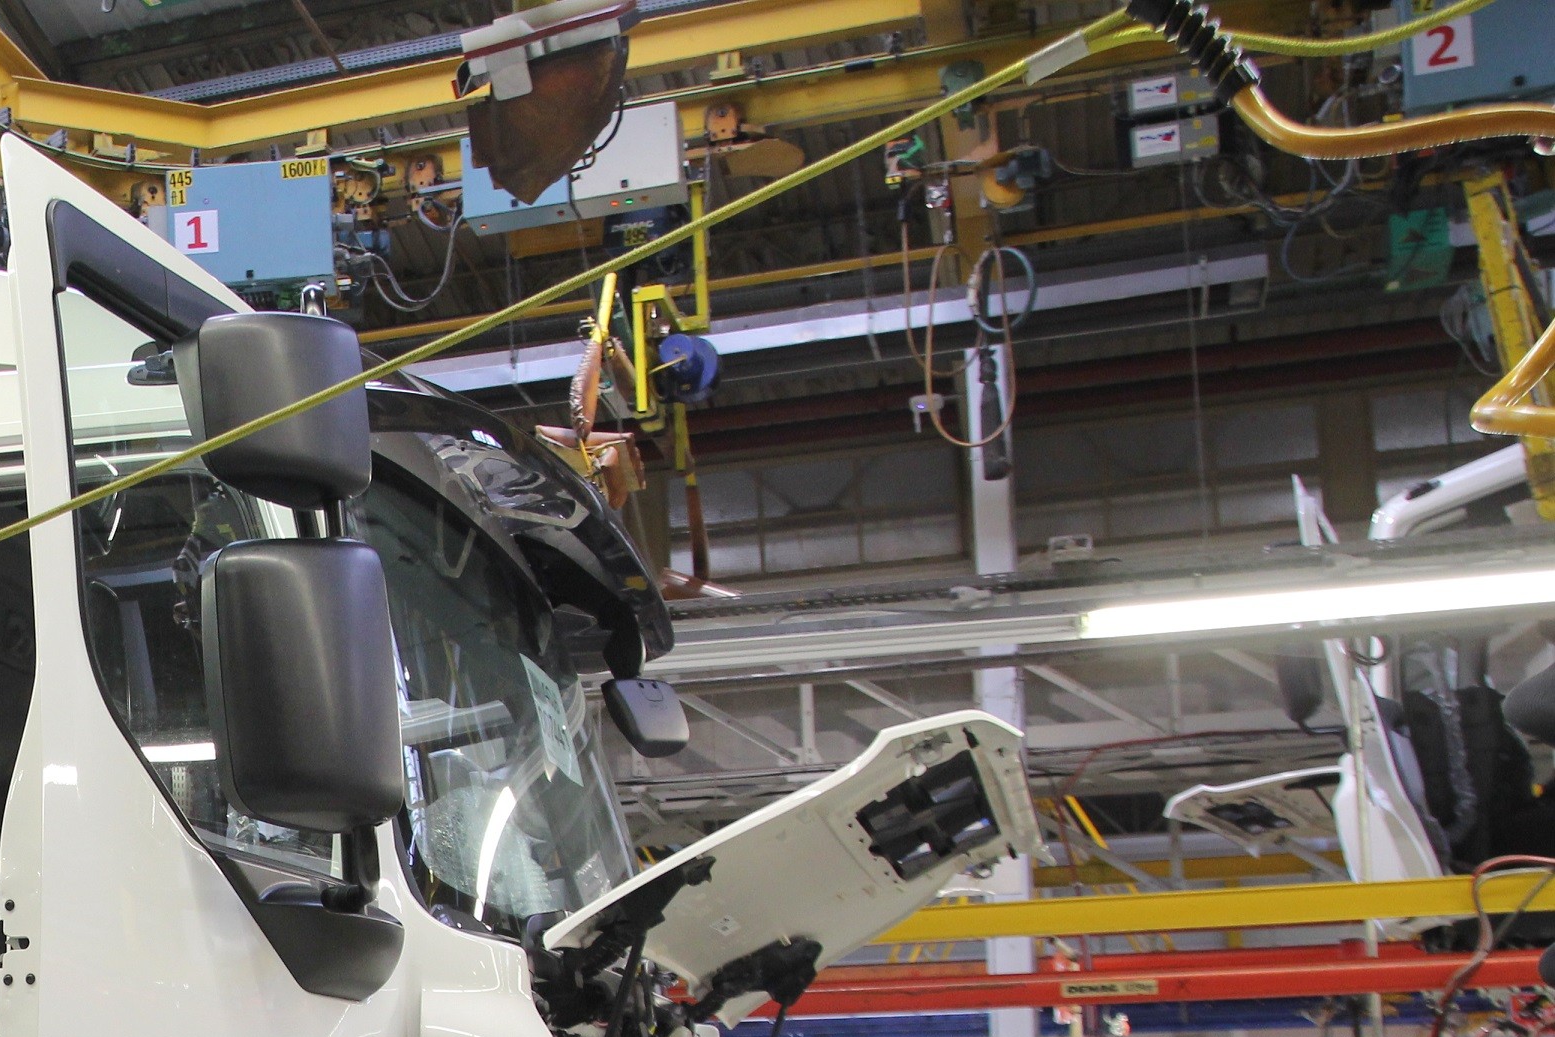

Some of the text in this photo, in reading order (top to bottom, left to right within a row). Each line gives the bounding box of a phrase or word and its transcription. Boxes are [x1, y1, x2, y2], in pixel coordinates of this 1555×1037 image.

[1427, 25, 1459, 67] 2
[169, 171, 192, 187] 445
[282, 158, 327, 178] 1600KG
[187, 216, 208, 249] 1
